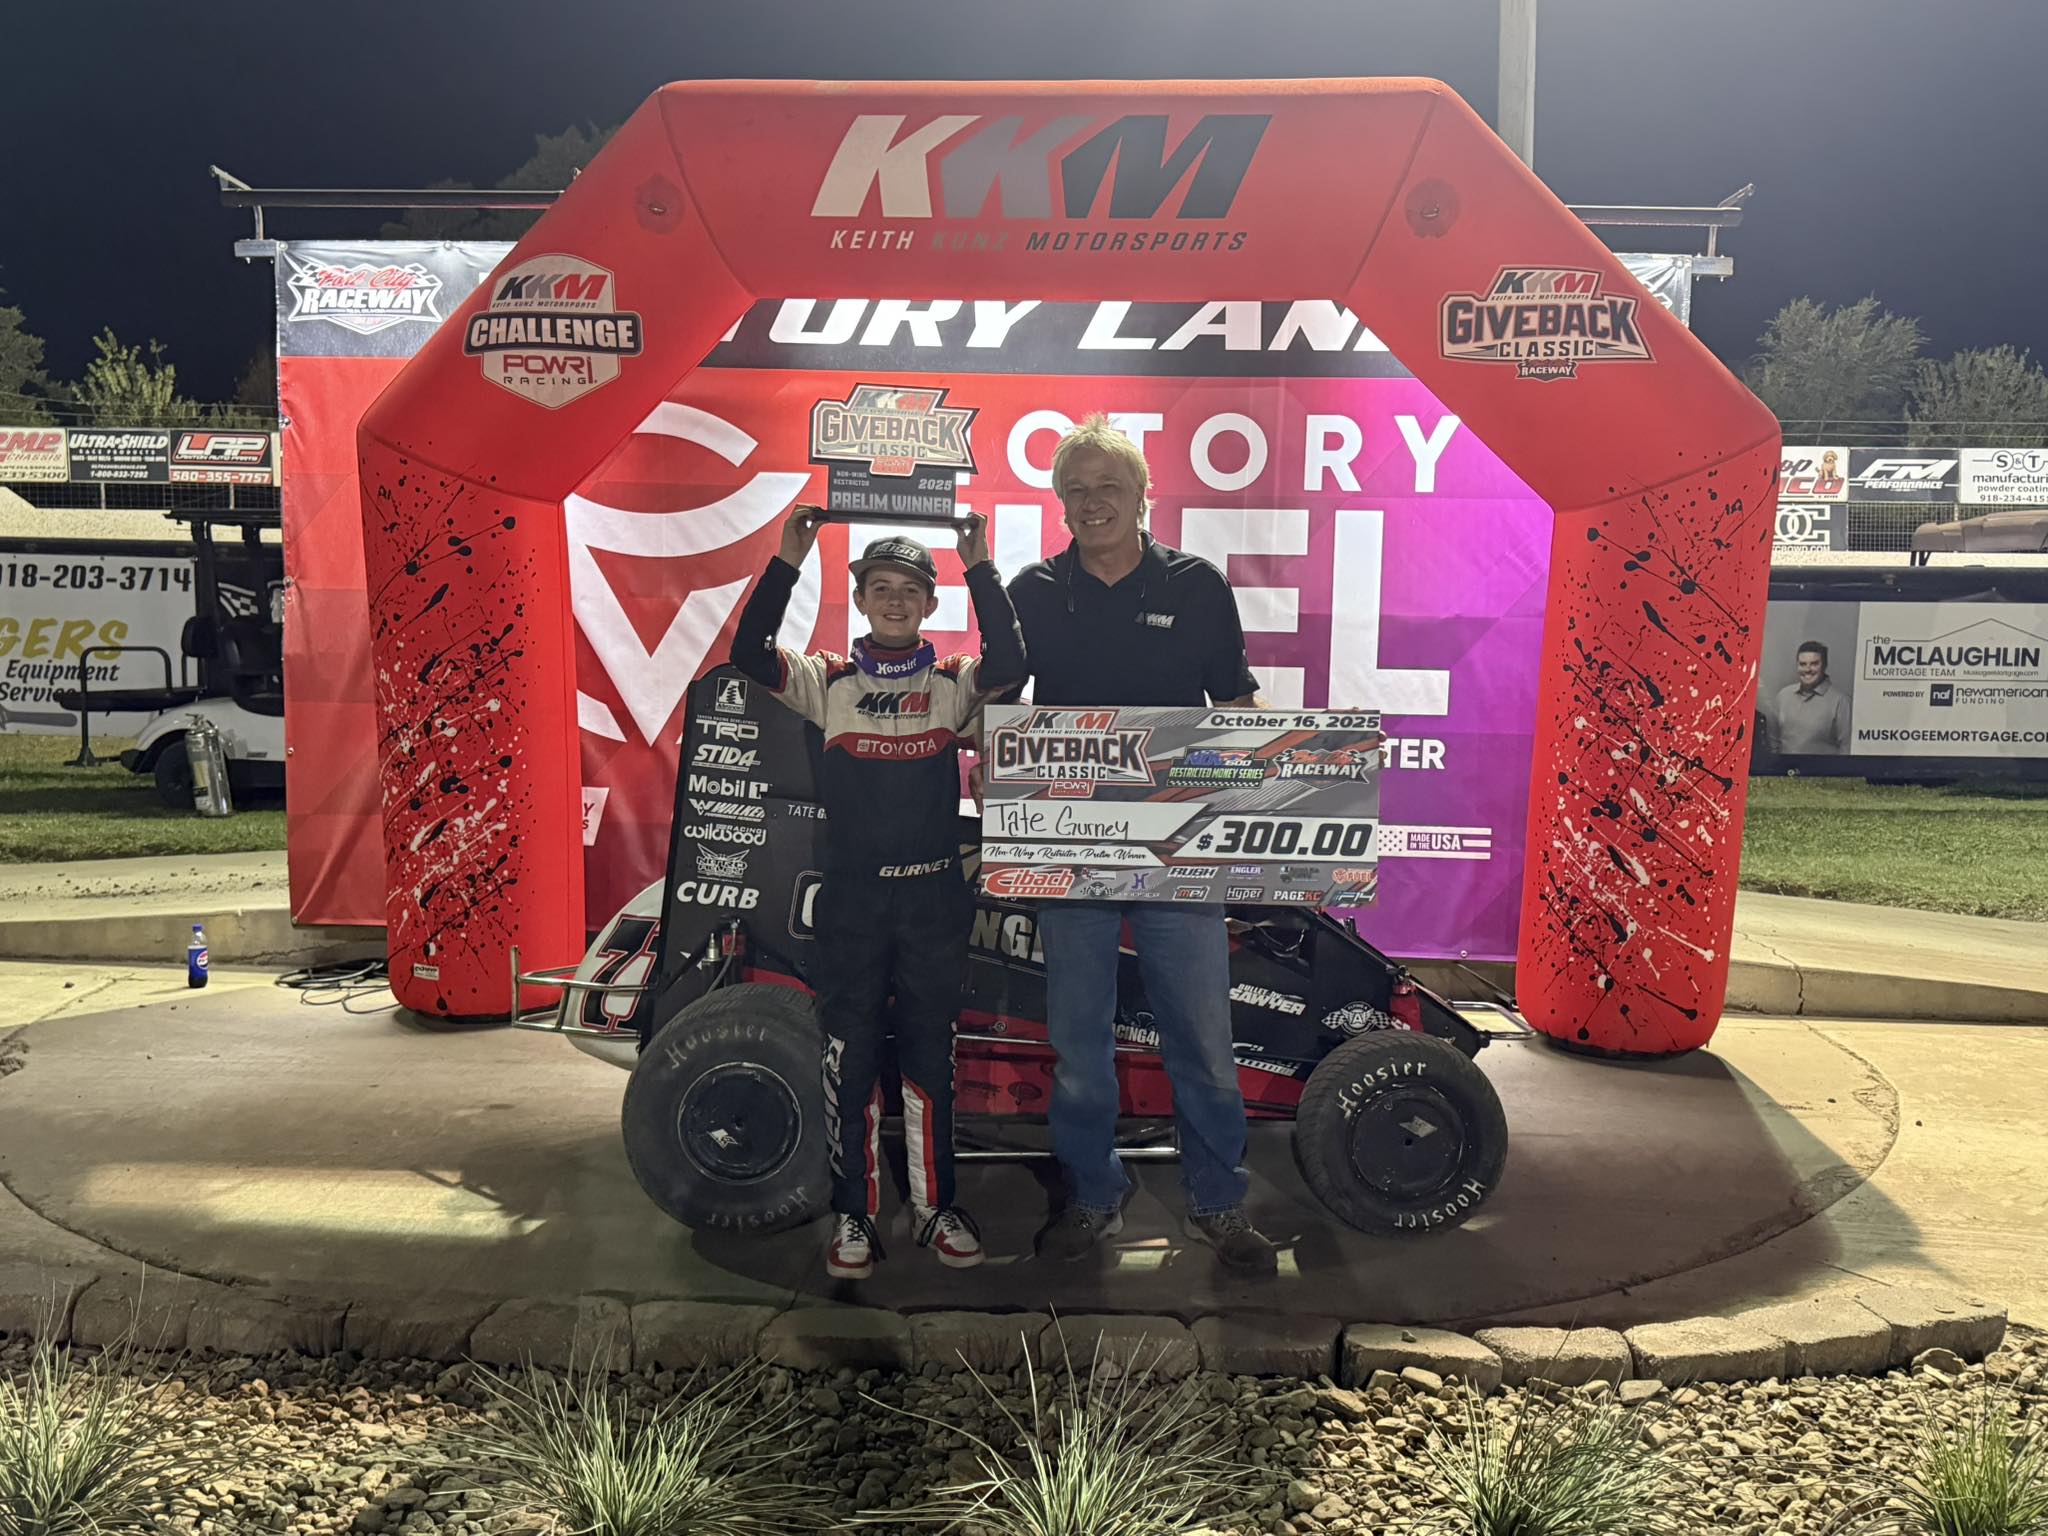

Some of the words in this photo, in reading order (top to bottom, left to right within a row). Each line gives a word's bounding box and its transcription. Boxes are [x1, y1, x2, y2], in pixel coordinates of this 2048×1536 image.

[811, 114, 1273, 219] KKM
[830, 230, 914, 249] KEITH
[932, 231, 1009, 251] KUNZ
[1026, 231, 1248, 252] MOTORSPORTS
[495, 274, 608, 301] KKM
[1494, 271, 1595, 294] KKM
[301, 289, 431, 314] RACEWAY
[1077, 300, 1391, 351] LAN
[1448, 300, 1640, 346] GIVEBACK
[470, 317, 635, 349] CHALLENGE
[1500, 340, 1595, 357] CLASSIC
[1522, 366, 1572, 376] RACEWAY
[504, 377, 586, 385] RACING
[821, 408, 962, 453] GIVEBACK
[177, 435, 267, 457] LAP
[859, 442, 926, 459] CLASSIC
[172, 470, 270, 482] 580-355-7757
[918, 478, 953, 491] 2025
[1864, 480, 1944, 489] PERFORMANCE
[1977, 484, 2015, 493] powder
[831, 491, 888, 511] PRELIM
[891, 494, 952, 514] WINNER
[1872, 634, 1891, 644] the
[1873, 646, 2040, 667] MCLAUGHLIN
[6, 659, 121, 684] Equipment
[1872, 668, 1927, 677] MORTGAGE
[1930, 668, 1956, 676] TEAM
[1883, 690, 1914, 698] POWERED
[1933, 688, 1951, 699] naf
[855, 691, 931, 714] KKM
[1032, 712, 1112, 729] KKM
[1210, 714, 1287, 728] October
[1293, 716, 1321, 730] 16,
[1326, 716, 1379, 728] 2025
[695, 718, 760, 742] TRD
[693, 743, 762, 767] STIDA
[869, 738, 937, 755] TOYOTA
[998, 732, 1142, 770] GIVEBACK
[1037, 766, 1106, 779] CLASSIC
[1169, 767, 1212, 777] RESTRICTED
[1212, 768, 1238, 778] MONEY
[1238, 769, 1264, 779] SERIES
[1281, 763, 1362, 778] RACEWAY
[688, 774, 745, 798] Mobil
[788, 804, 815, 818] TATE
[727, 825, 762, 834] RACING
[986, 802, 1047, 837] Tate
[1055, 805, 1129, 840] Gurney
[684, 823, 767, 846] wilwood
[1410, 834, 1431, 842] MADE
[1432, 835, 1461, 850] USA
[1037, 848, 1078, 859] Restrictor
[1080, 848, 1111, 860] Prelim
[1113, 850, 1148, 860] Winner
[879, 857, 953, 877] GURNEY
[1169, 867, 1217, 878] RUSH
[1230, 866, 1262, 875] ENGLER
[985, 868, 1075, 897] Eibach
[676, 880, 760, 909] CURB
[1226, 886, 1263, 900] Hyper
[1273, 890, 1321, 901] PAGEKC
[1239, 983, 1266, 994] BULLET
[1229, 987, 1306, 1016] SAWYER
[1336, 1061, 1428, 1119] Hoosier
[1393, 1177, 1487, 1232] Hoosier
